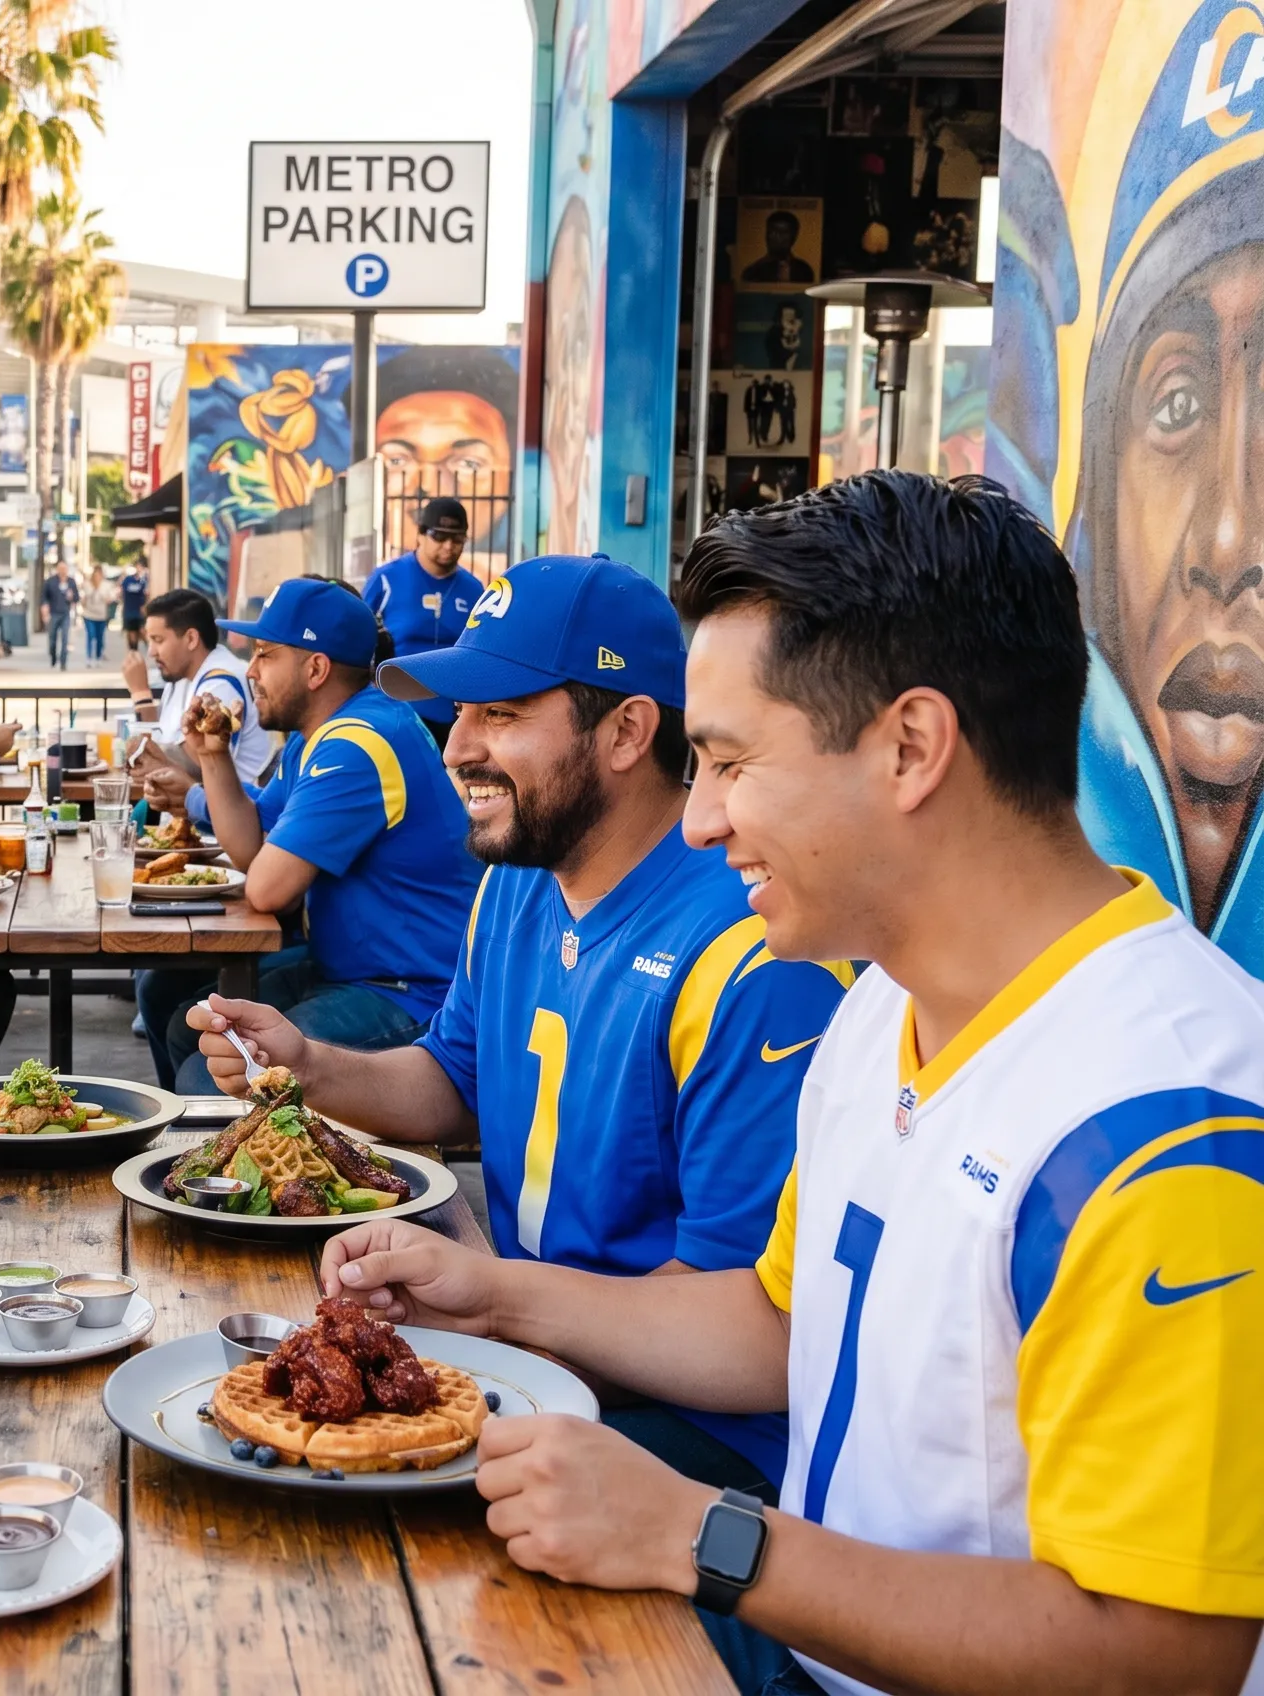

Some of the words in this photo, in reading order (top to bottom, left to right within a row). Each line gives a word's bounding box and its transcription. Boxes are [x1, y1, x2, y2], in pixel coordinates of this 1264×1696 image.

[285, 155, 453, 192] METRO
[263, 206, 474, 243] PARKING
[355, 259, 384, 294] P
[959, 1154, 999, 1194] RAMS
